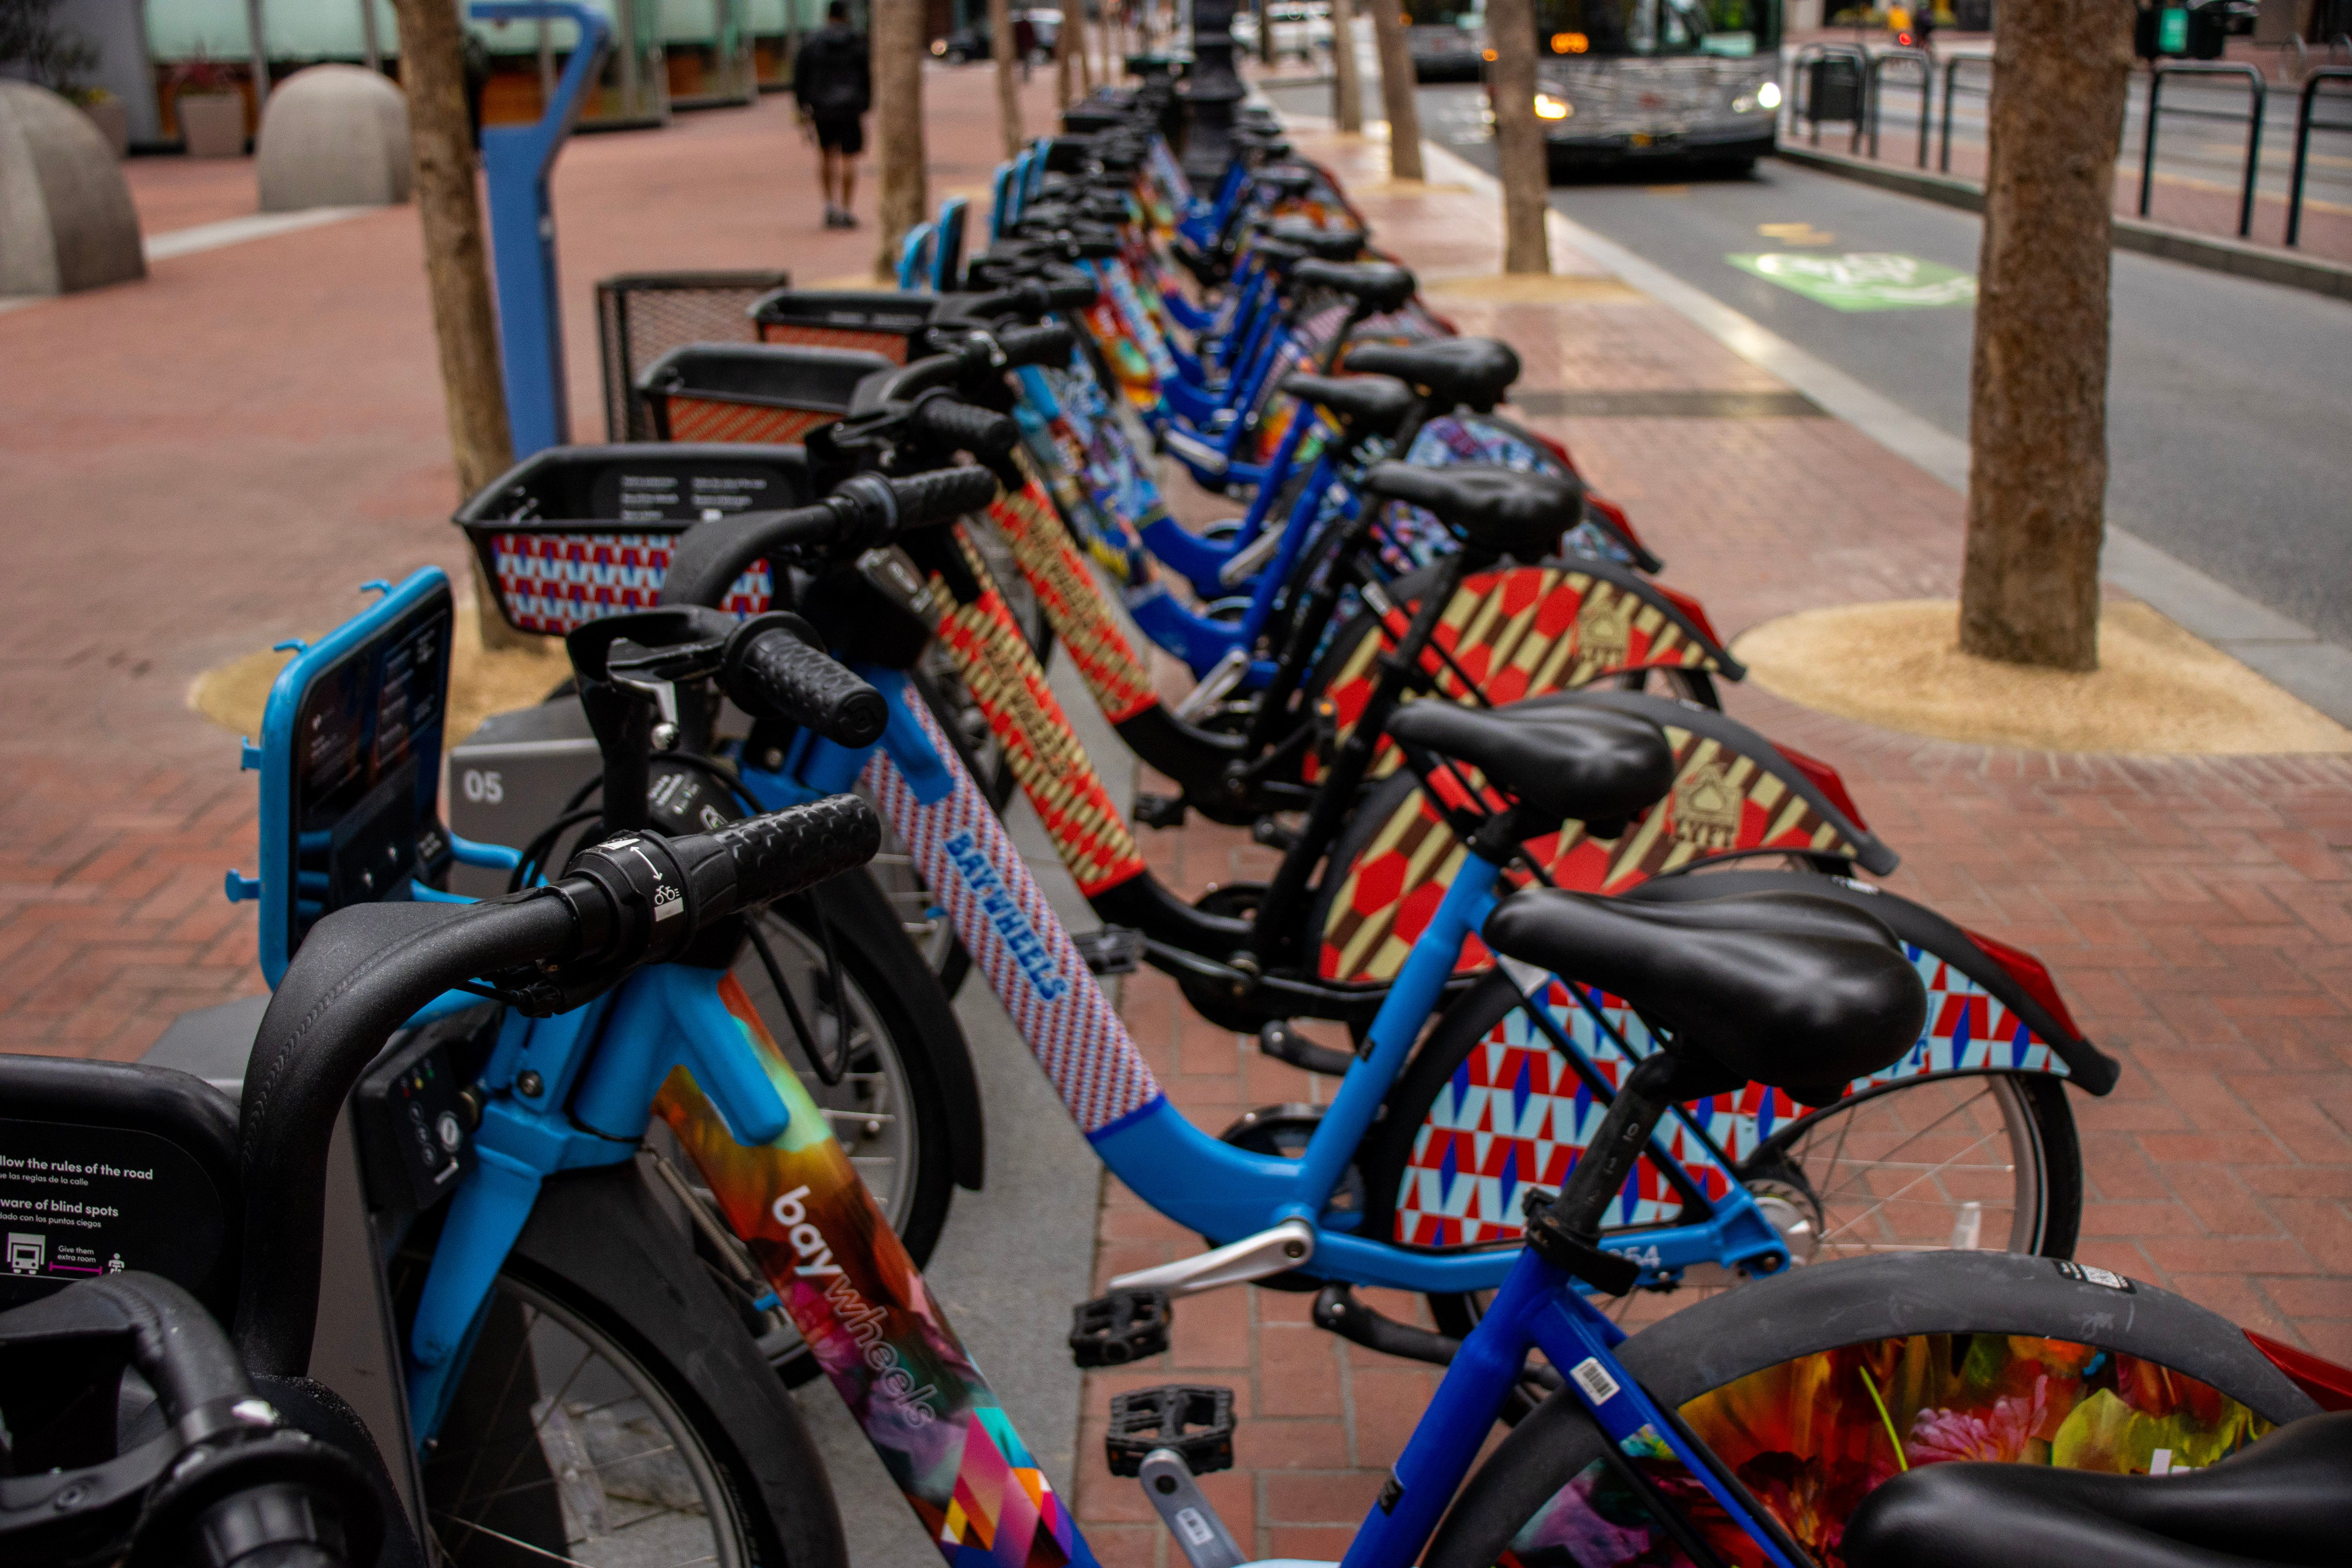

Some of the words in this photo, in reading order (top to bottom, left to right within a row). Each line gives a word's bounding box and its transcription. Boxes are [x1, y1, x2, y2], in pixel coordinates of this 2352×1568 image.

[464, 769, 504, 804] 05
[27, 1158, 48, 1170] the
[51, 1160, 82, 1173] rules
[84, 1163, 98, 1174] of
[100, 1164, 121, 1176] the
[123, 1169, 153, 1180] road
[9, 1172, 20, 1180] las
[22, 1174, 47, 1183] reglas
[49, 1175, 58, 1183] de
[61, 1176, 68, 1184] la
[70, 1178, 89, 1186] calle
[0, 1199, 32, 1209] ware
[35, 1199, 49, 1210] of
[51, 1200, 82, 1214] blind
[85, 1206, 119, 1217] spots
[36, 1214, 47, 1223] los
[49, 1216, 75, 1225] puntos
[76, 1219, 102, 1229] ciegos
[58, 1245, 74, 1253] Give
[76, 1247, 94, 1255] them
